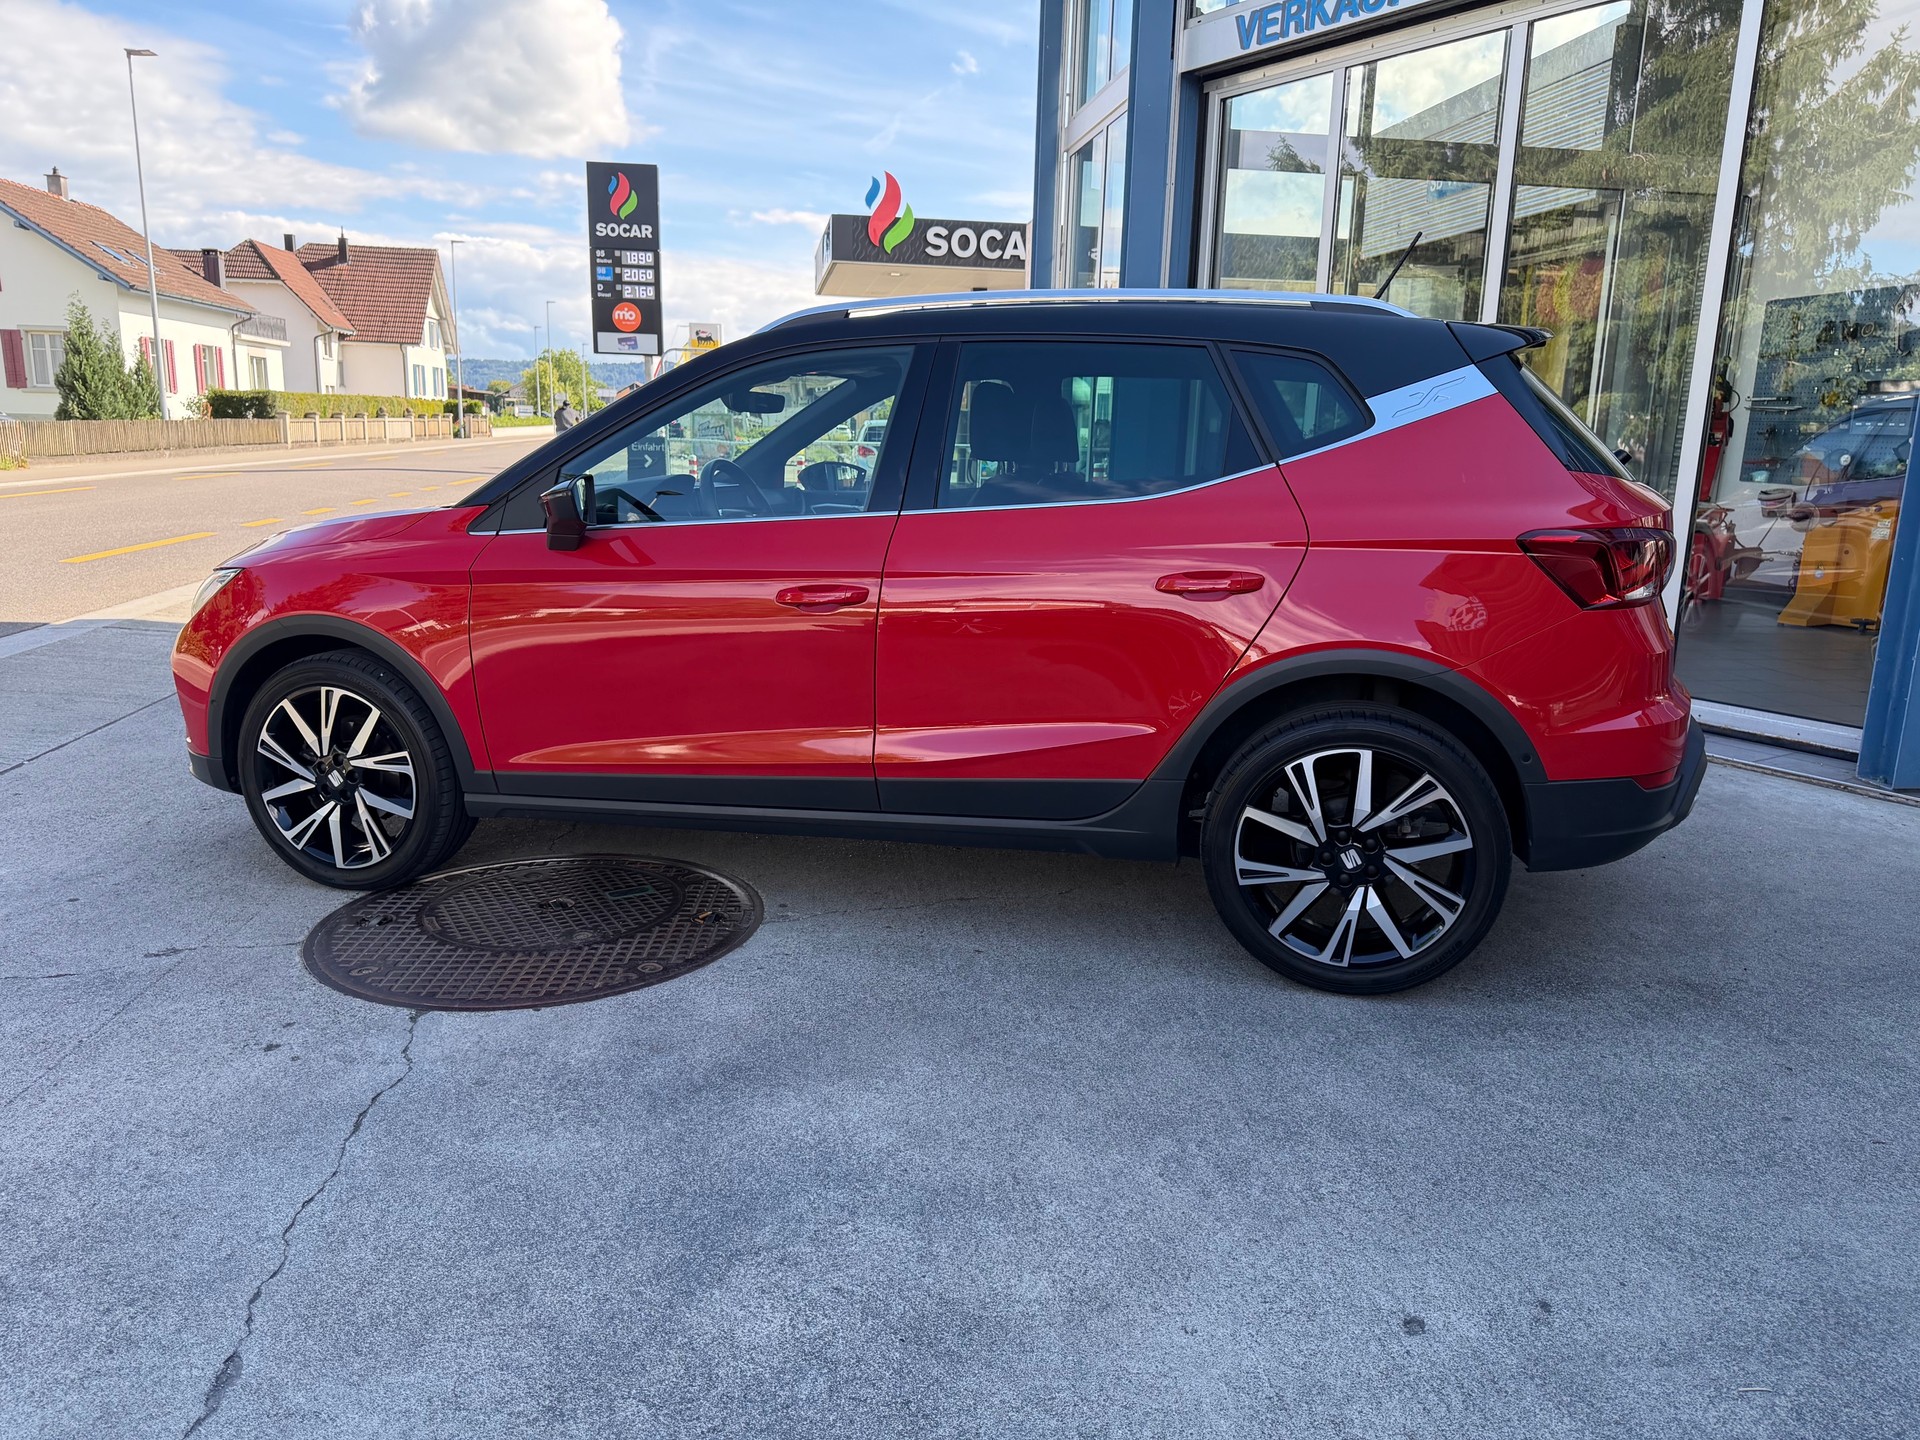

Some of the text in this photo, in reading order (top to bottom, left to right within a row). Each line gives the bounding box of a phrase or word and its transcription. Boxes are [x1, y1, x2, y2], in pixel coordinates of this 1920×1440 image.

[1235, 0, 1399, 50] VERKA
[595, 222, 653, 239] SOCAR
[925, 225, 1026, 261] SOCA
[615, 307, 636, 320] mio
[631, 442, 665, 452] Einfahrt
